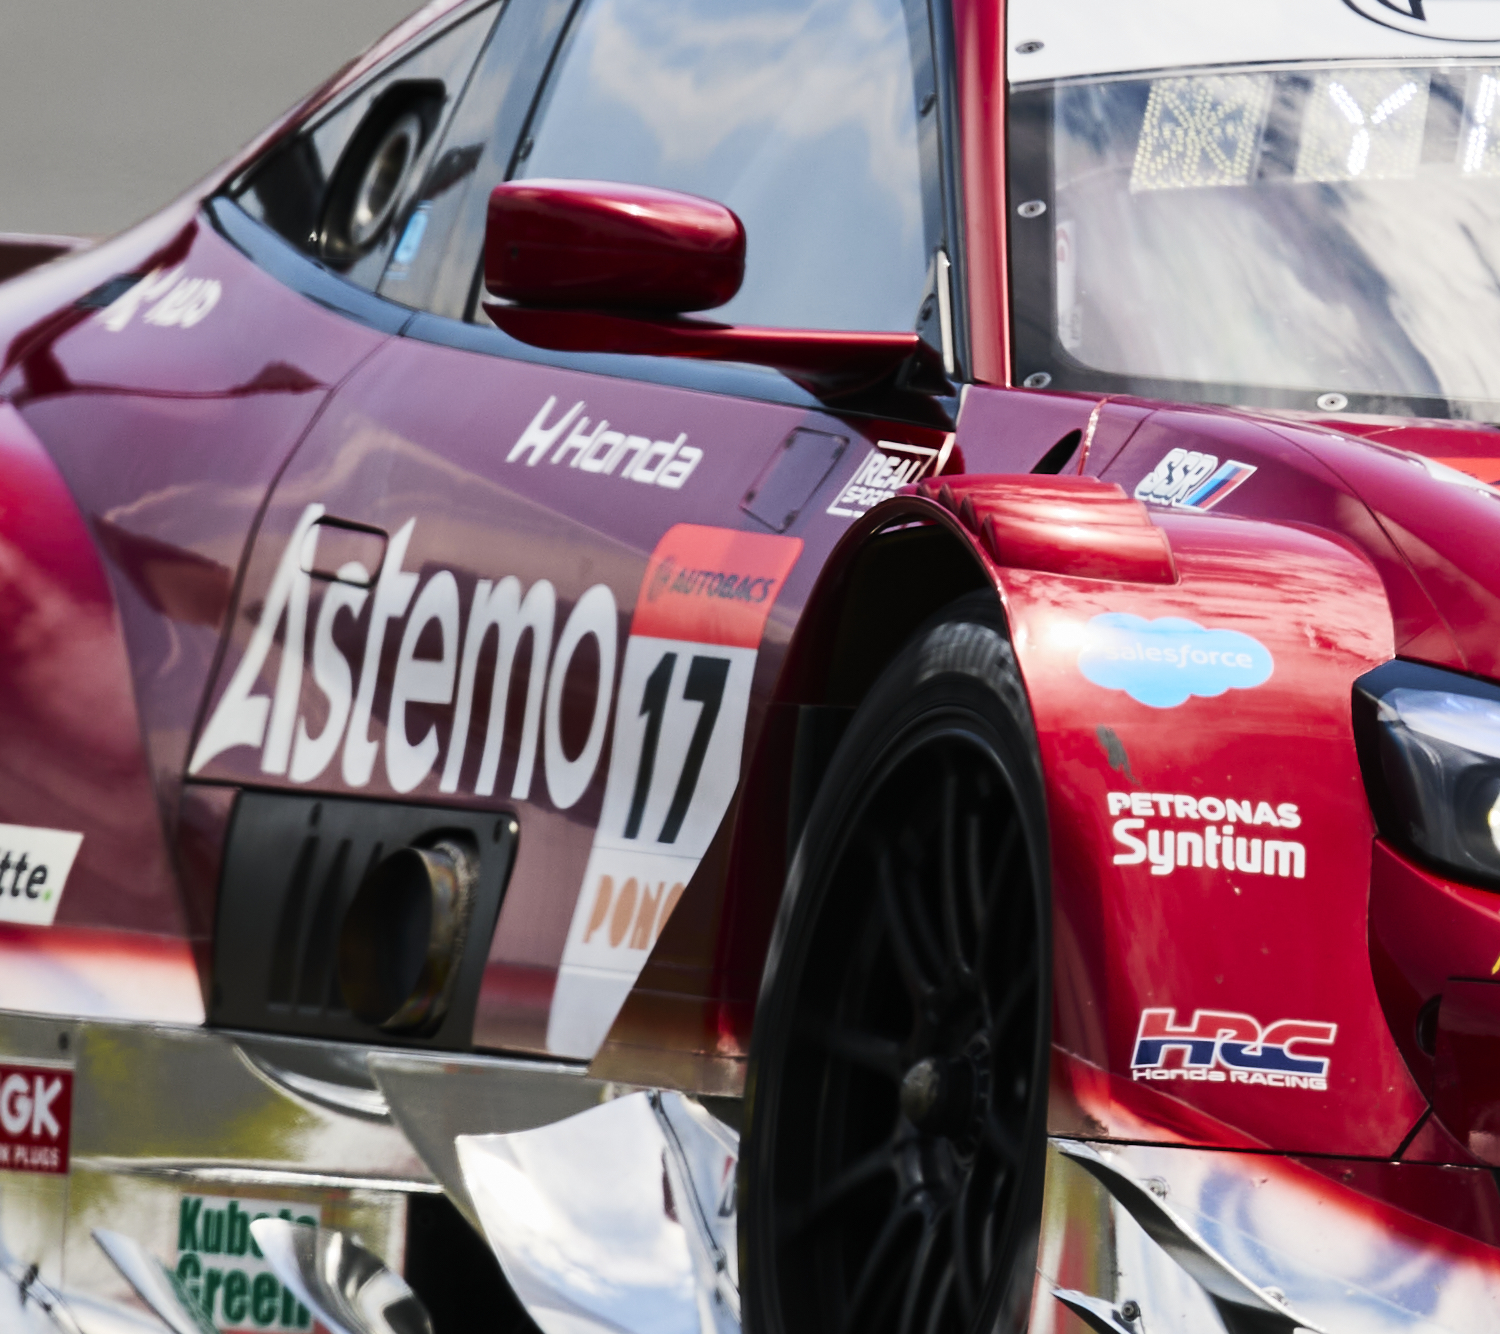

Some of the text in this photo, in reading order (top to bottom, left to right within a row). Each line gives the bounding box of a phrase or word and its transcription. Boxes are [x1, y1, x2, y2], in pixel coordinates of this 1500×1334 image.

[551, 416, 704, 490] Honda
[855, 452, 922, 489] REAL
[668, 568, 776, 603] AUTOBACS
[189, 503, 619, 810] Astemo
[1105, 642, 1253, 669] salesforce
[623, 652, 732, 845] 17
[1107, 792, 1302, 829] PETRONAS
[1112, 819, 1306, 879] Syntium
[1130, 1007, 1338, 1077] HRC
[1132, 1068, 1328, 1091] Honda RACING
